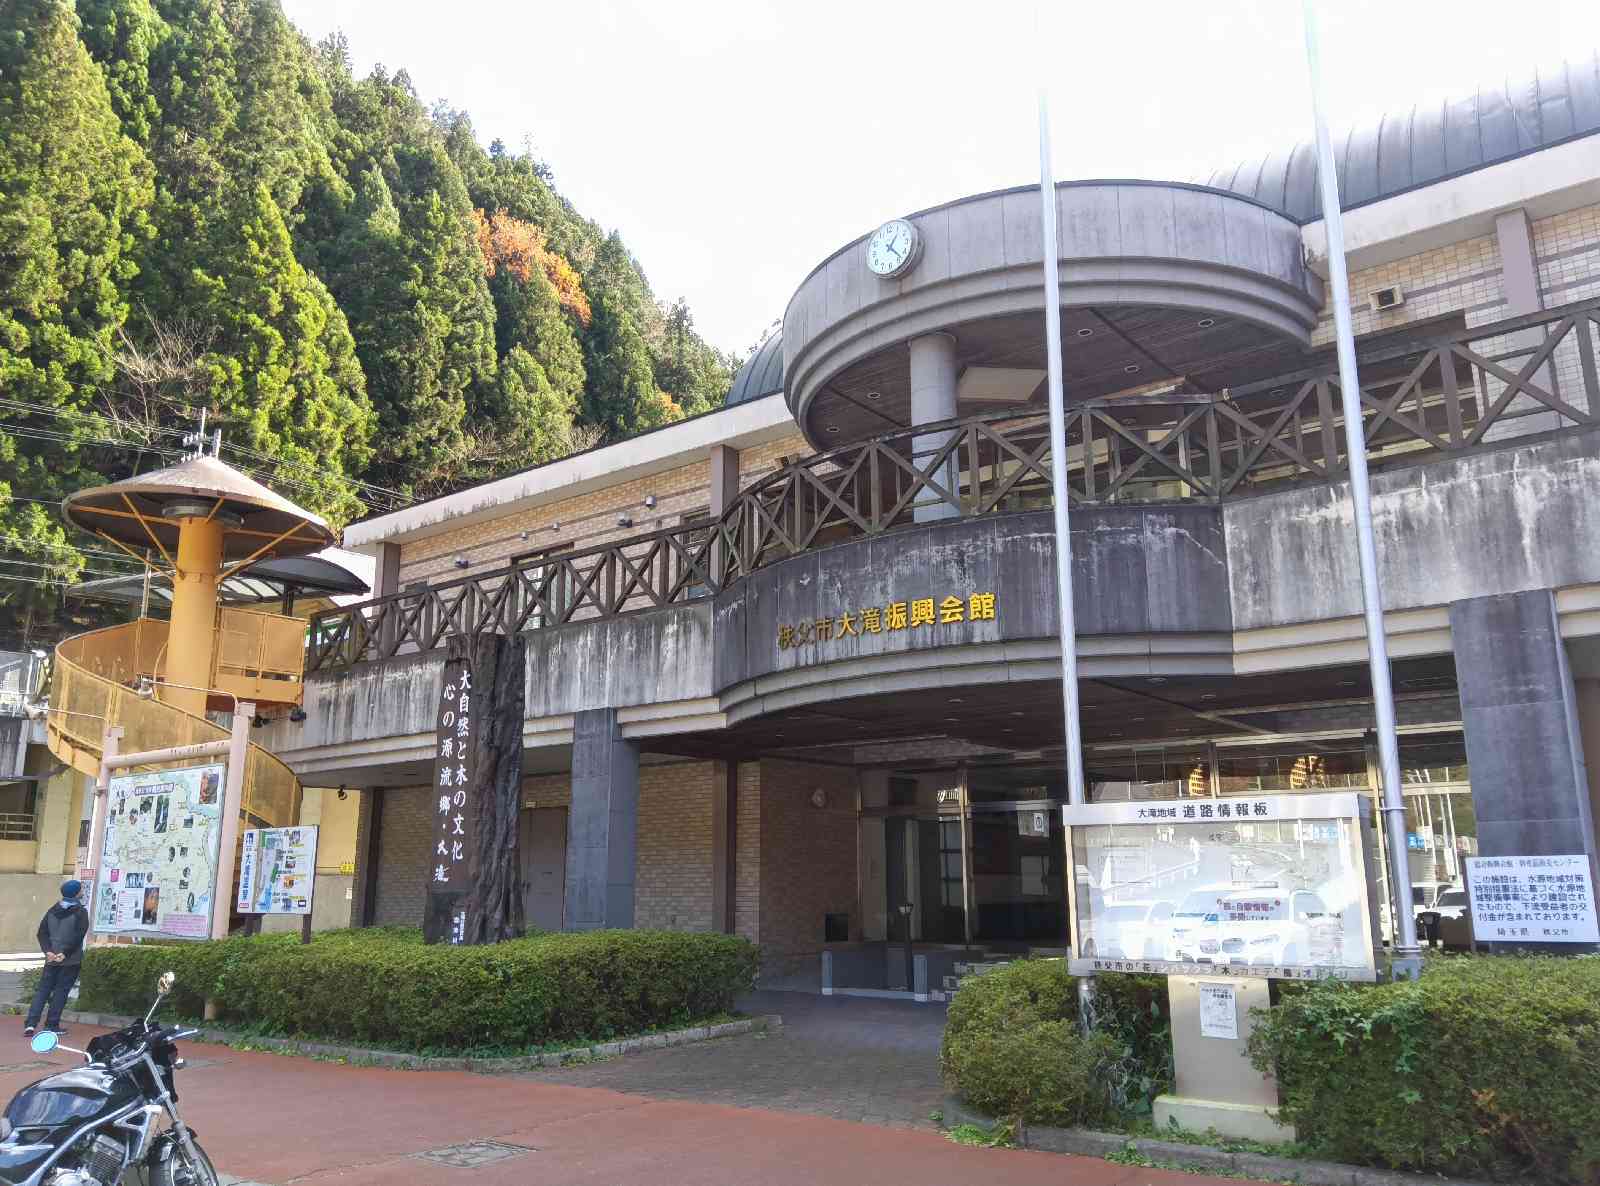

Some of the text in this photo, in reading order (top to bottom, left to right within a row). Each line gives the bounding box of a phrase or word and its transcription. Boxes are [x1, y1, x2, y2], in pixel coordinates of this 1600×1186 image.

[778, 592, 996, 650] 秩父市大滝振興会館
[1137, 802, 1268, 818] 大滝地域 道路情報板
[1497, 928, 1569, 936] 埼玉県 秩父市
